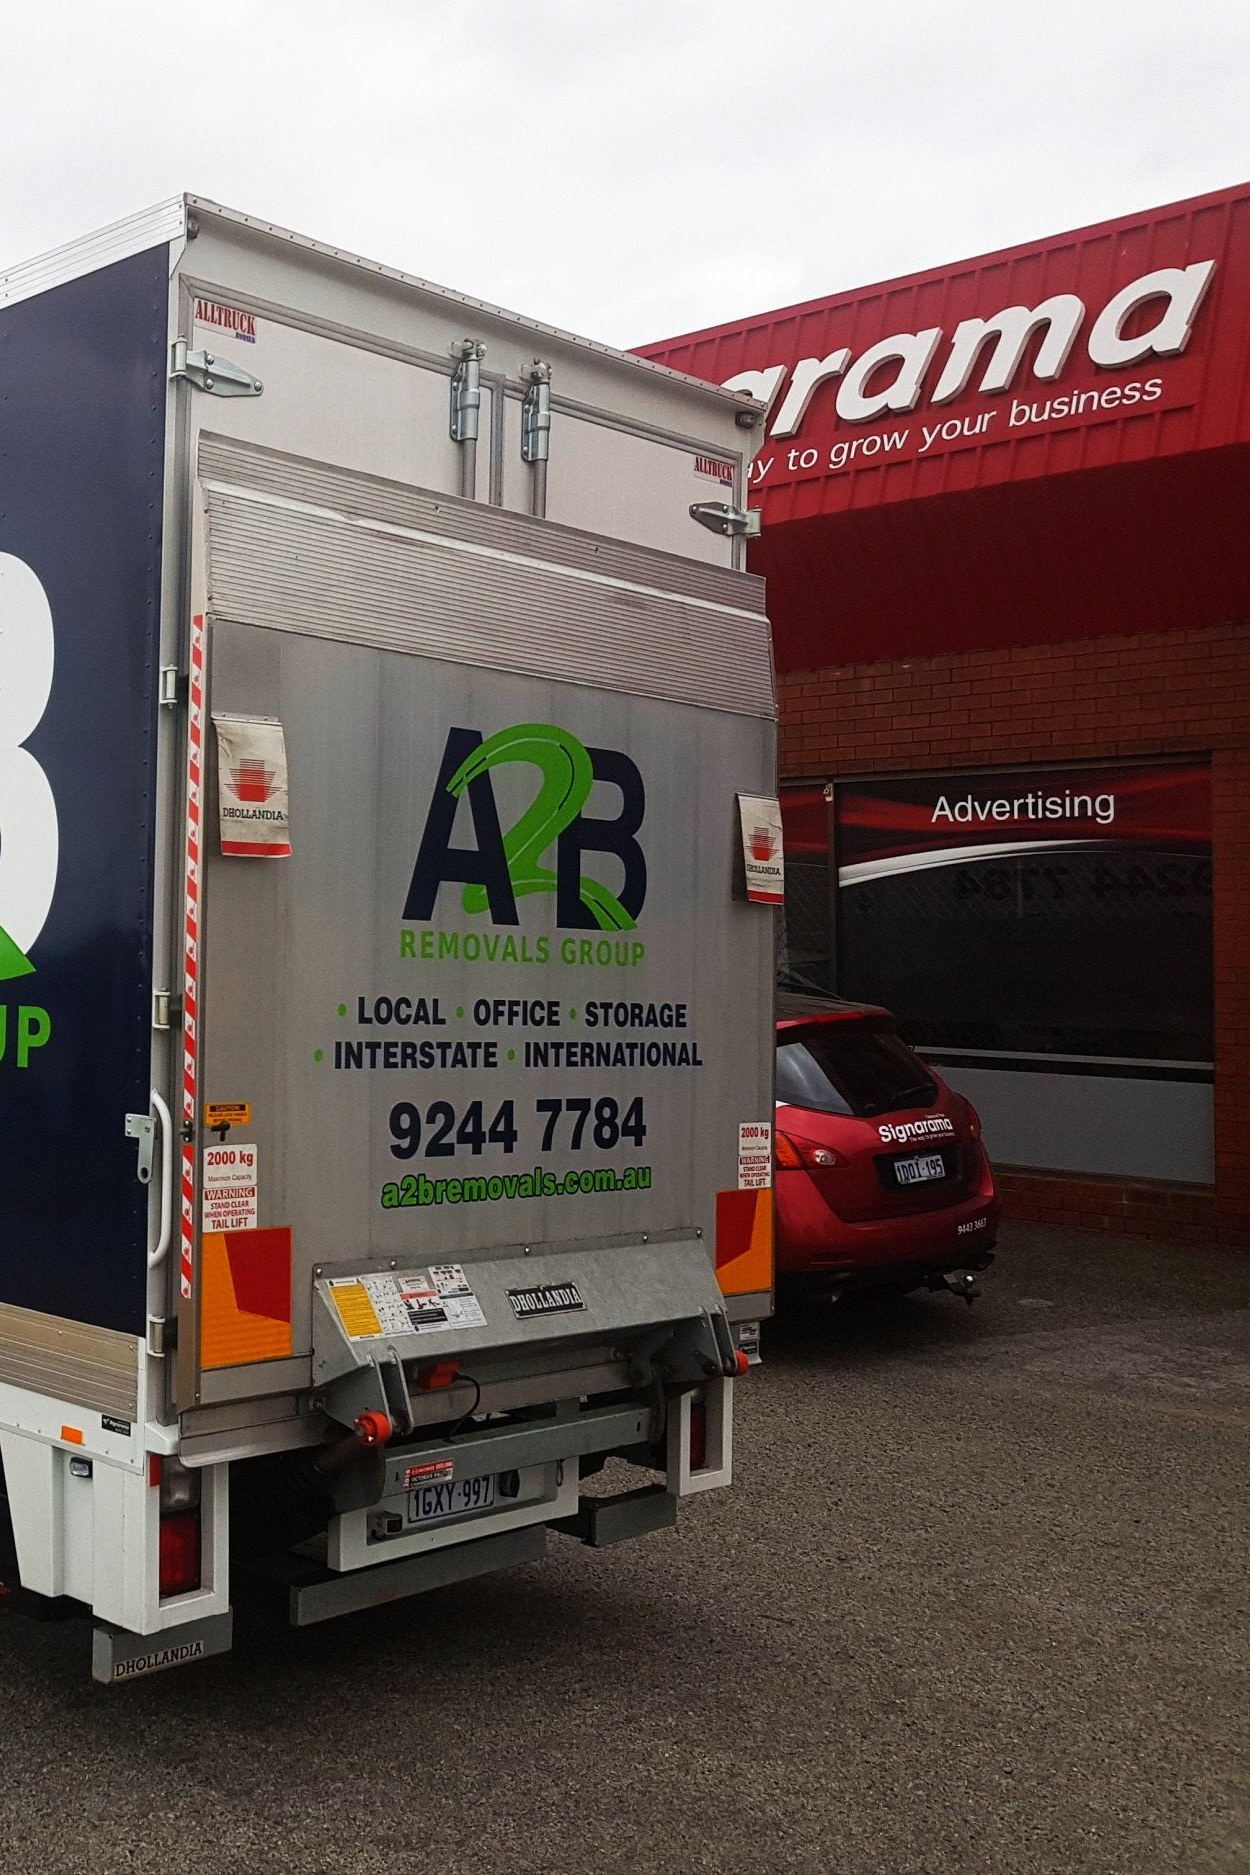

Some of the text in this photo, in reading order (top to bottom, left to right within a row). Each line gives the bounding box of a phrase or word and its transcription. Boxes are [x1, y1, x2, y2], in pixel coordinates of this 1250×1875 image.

[195, 300, 256, 336] ALLTRUCK
[787, 448, 818, 472] to
[830, 427, 909, 475] grow
[921, 412, 997, 453] your
[1009, 377, 1163, 427] business
[694, 457, 733, 481] ALLTRUCK
[222, 807, 284, 821] DHOLLANDIA
[931, 790, 1116, 824] Advertising
[401, 723, 647, 931] A2B
[400, 929, 645, 967] REMOVALS GROUP
[357, 996, 687, 1028] LOCAL OFFICE STORAGE
[334, 1041, 703, 1069] INTERSTATE INTERNATIONAL
[389, 1096, 647, 1160] 9244 7784
[741, 1127, 769, 1139] 2000 kg
[878, 1118, 954, 1143] Signarama
[207, 1150, 253, 1167] 2000 kg
[207, 1187, 254, 1200] WARNING
[381, 1166, 651, 1209] a2bremovals.com.au
[204, 1208, 255, 1219] WHEN OPERATING
[211, 1200, 249, 1210] STAND CLEAR
[211, 1217, 248, 1229] TAIL LIFT
[510, 1287, 582, 1312] DHOLLANDIA
[116, 1642, 202, 1677] DHOLLANDIA
